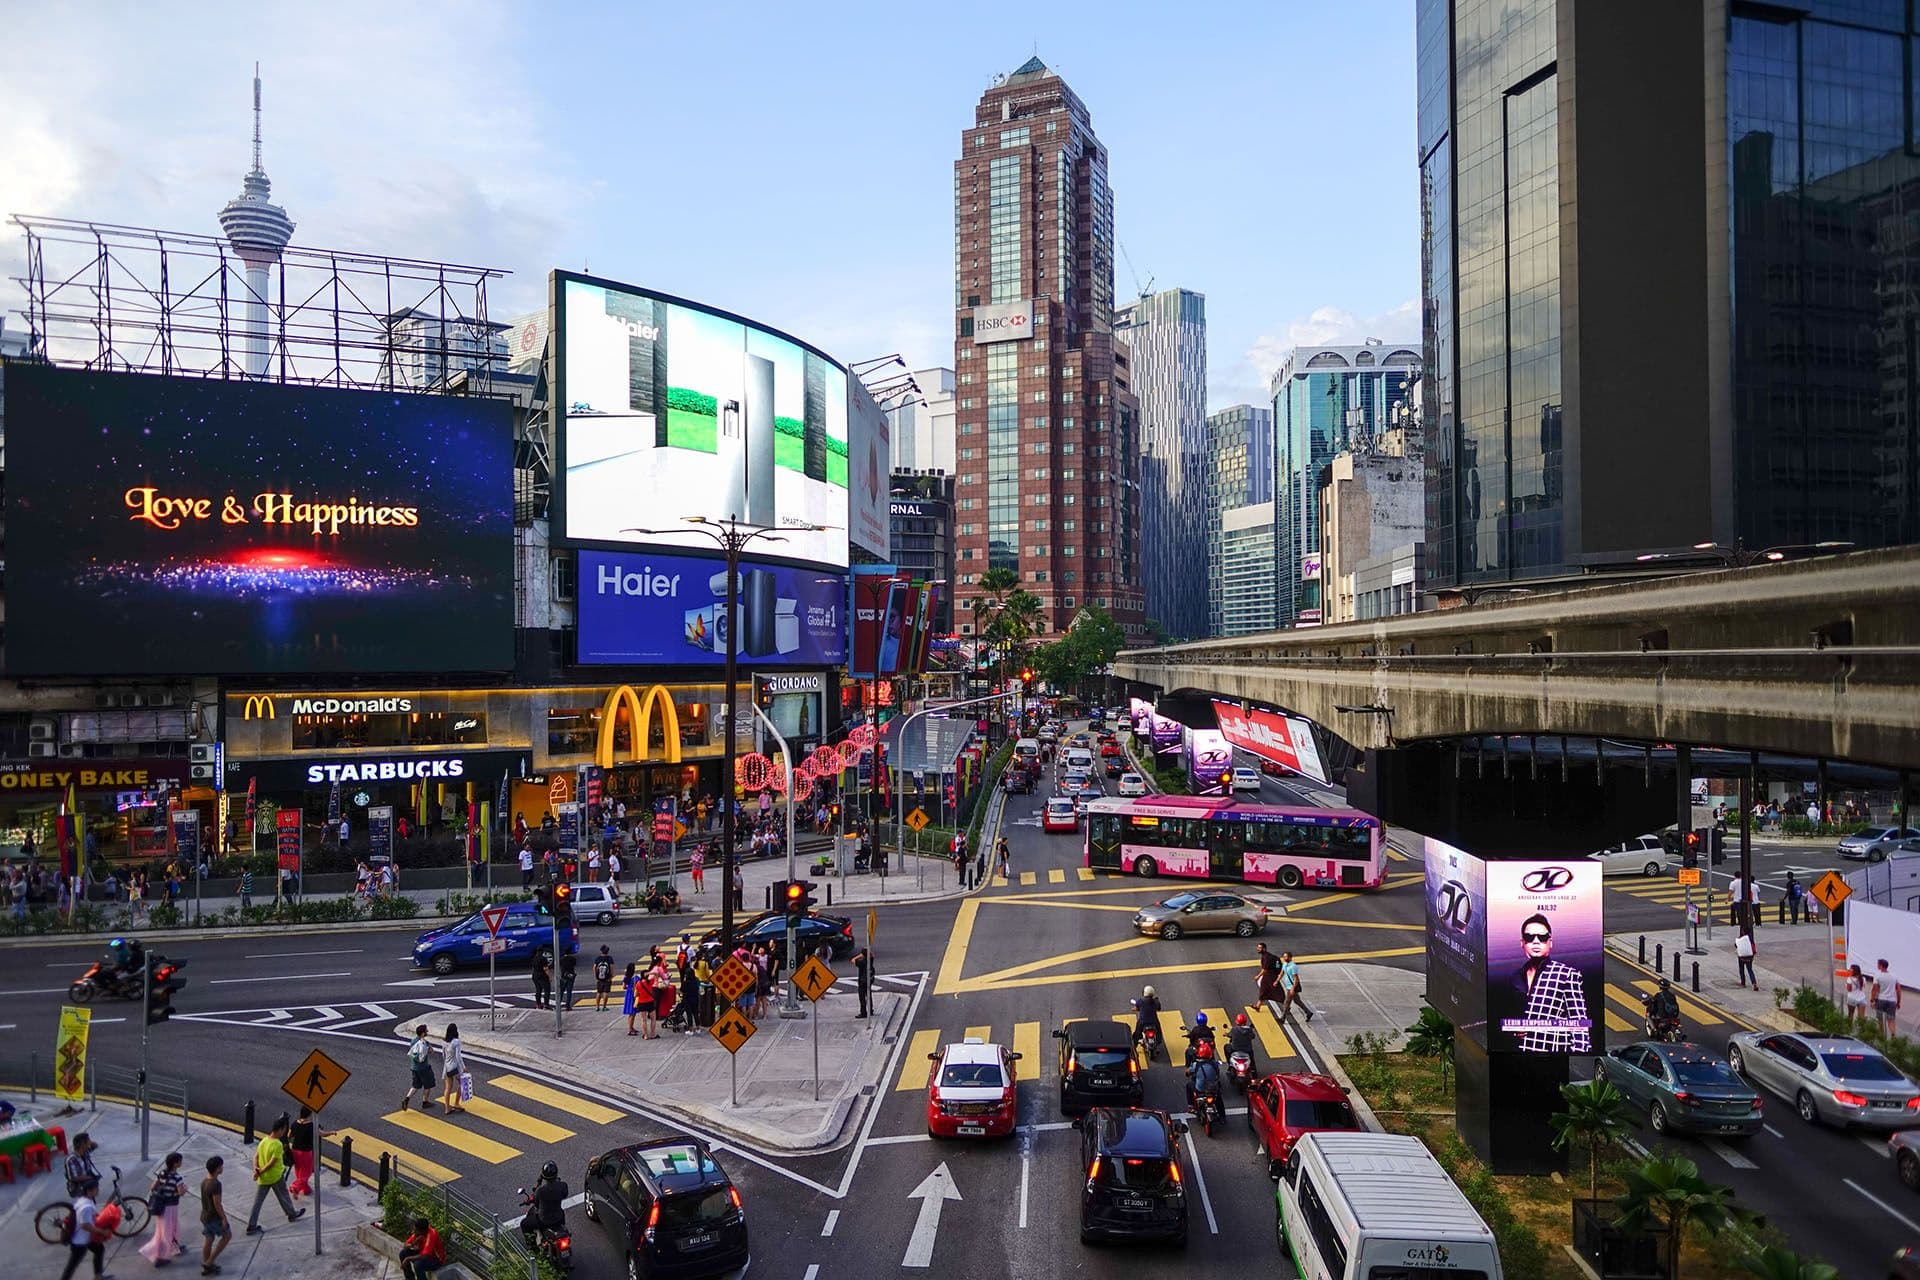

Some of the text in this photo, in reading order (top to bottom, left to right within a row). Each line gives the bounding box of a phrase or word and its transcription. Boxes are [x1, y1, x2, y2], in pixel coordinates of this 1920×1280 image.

[977, 317, 1009, 331] HSBC
[125, 487, 419, 535] Love & Happiness
[598, 565, 681, 597] Haier
[807, 605, 836, 628] Global #1
[769, 676, 818, 691] GIORDANO
[291, 698, 412, 714] McDonald's
[16, 764, 31, 772] KEK
[227, 762, 241, 772] KAFE
[307, 759, 464, 783] STARBUCKS
[0, 770, 149, 789] ONEY BAKE
